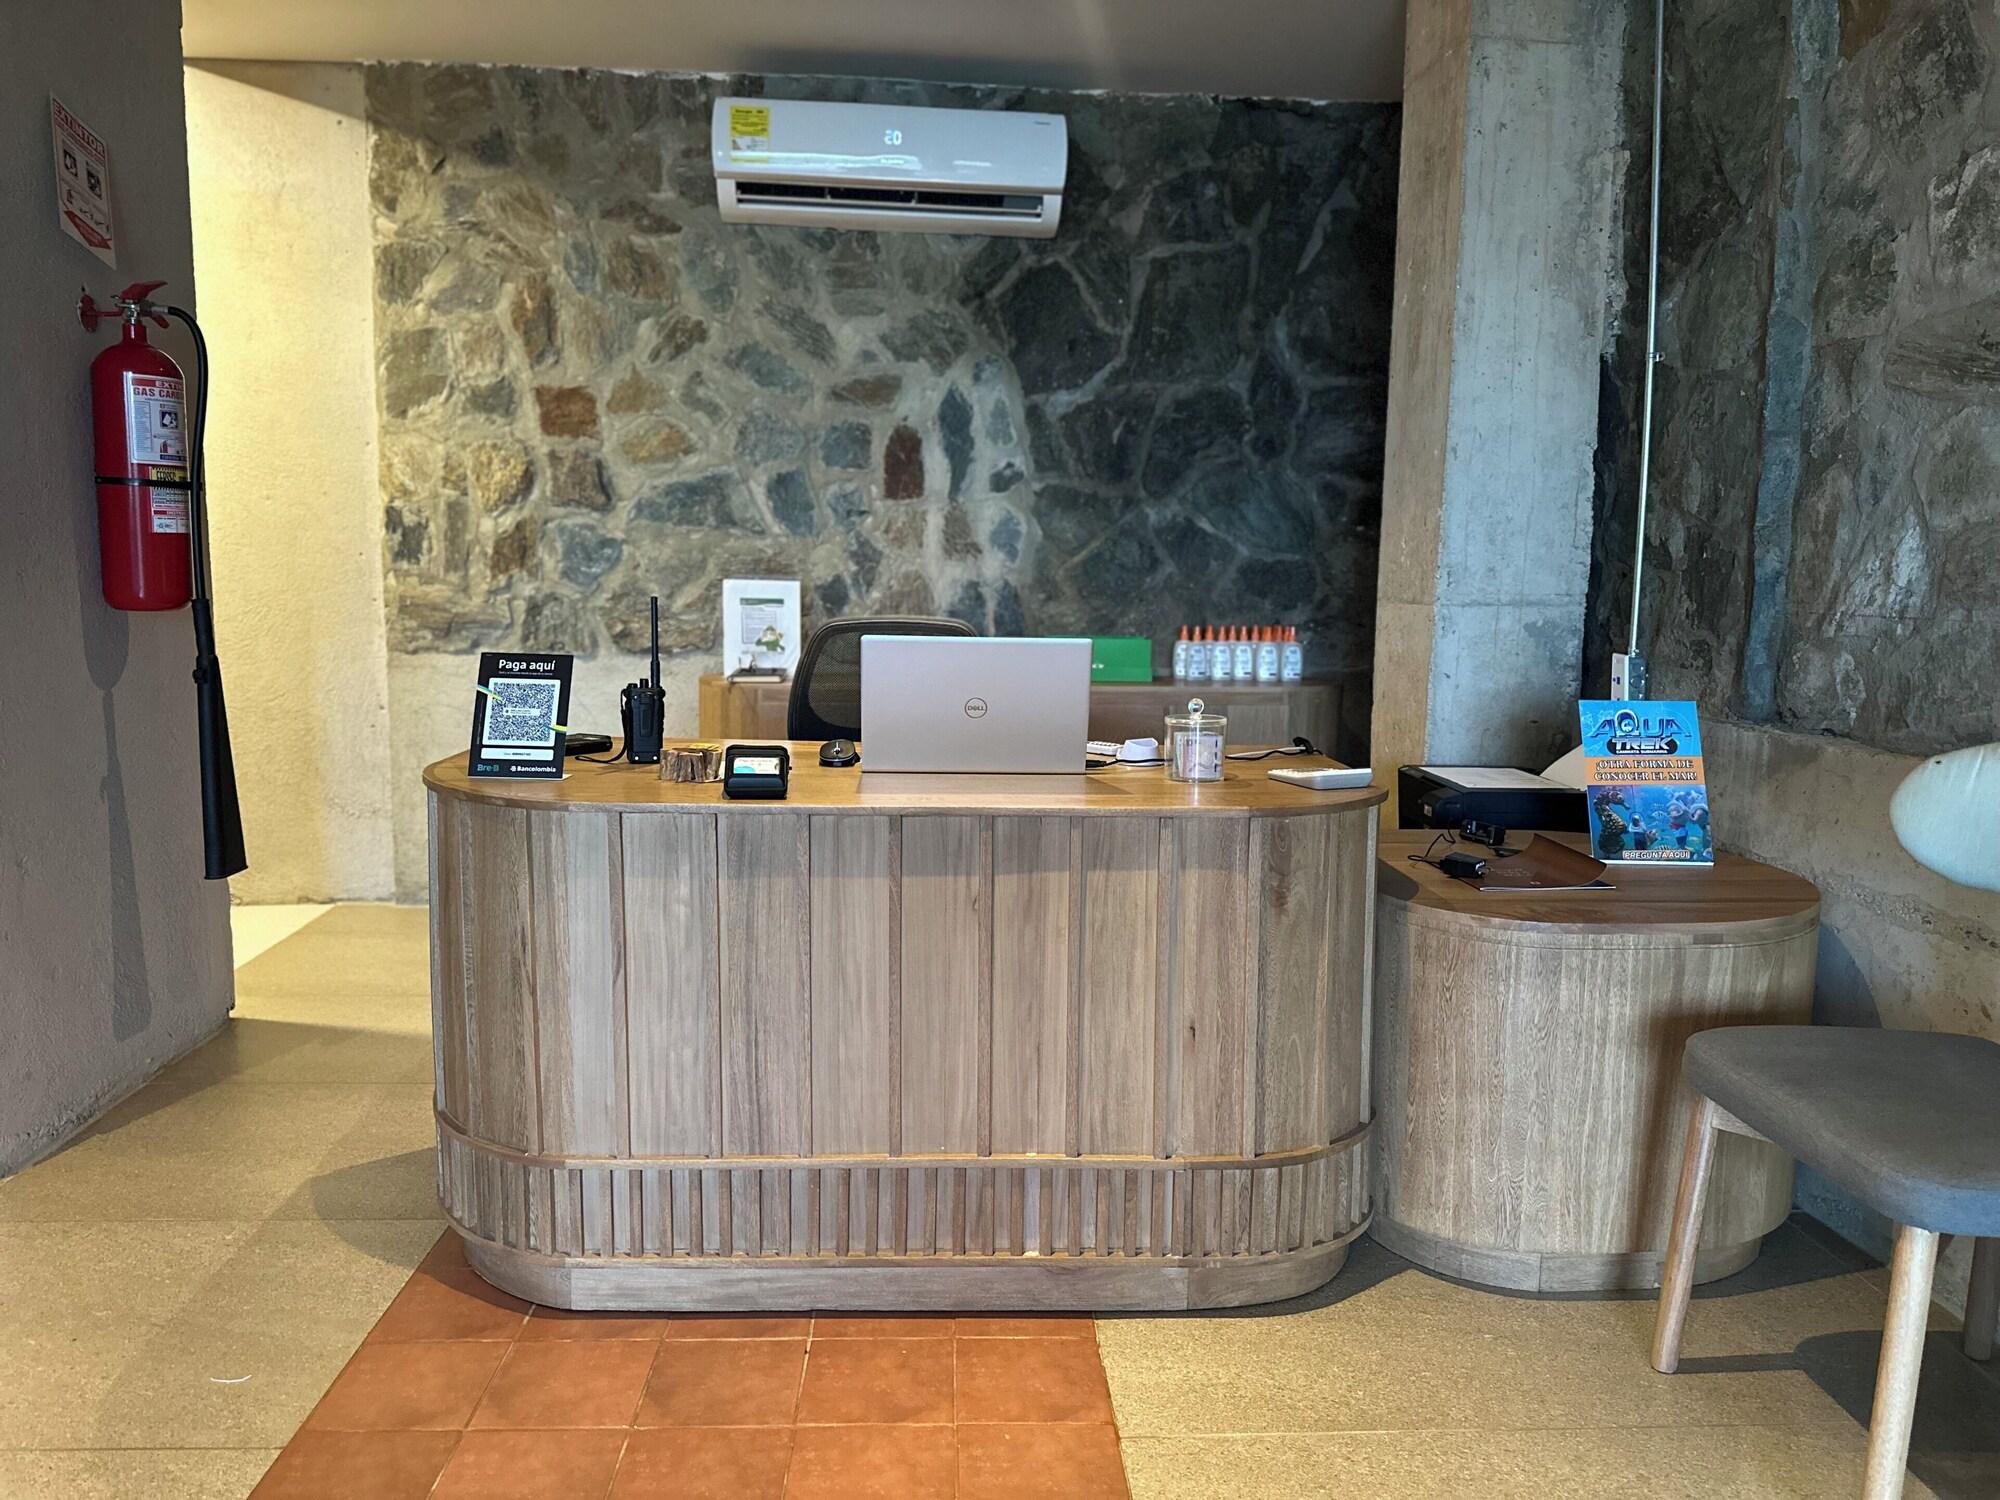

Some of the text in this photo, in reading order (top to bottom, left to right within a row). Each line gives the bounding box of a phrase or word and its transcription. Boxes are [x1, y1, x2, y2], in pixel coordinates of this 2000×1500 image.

[883, 129, 903, 146] 20
[133, 386, 156, 397] GAS
[498, 659, 556, 672] Paga aquí
[1586, 708, 1692, 738] AQUA
[1612, 738, 1673, 750] TREK
[477, 763, 557, 773] Bre-B Bancolombia
[1596, 759, 1694, 771] ¡OTRA FORMA DE
[1594, 771, 1697, 781] CONOCER EL MAR!
[1624, 851, 1668, 859] PREGUNTA
